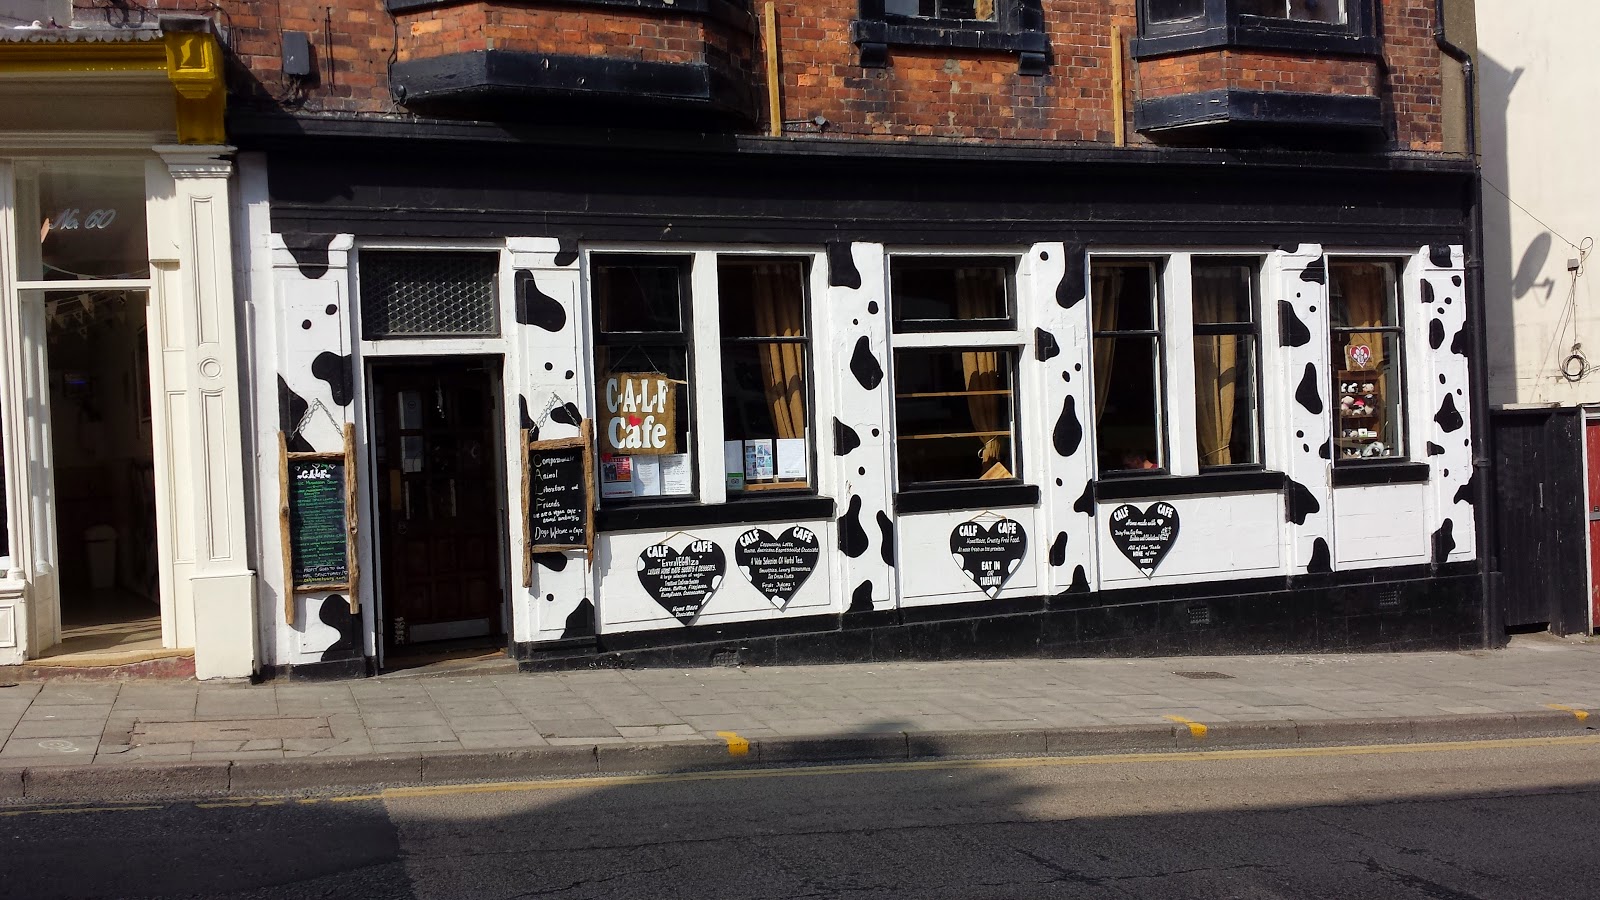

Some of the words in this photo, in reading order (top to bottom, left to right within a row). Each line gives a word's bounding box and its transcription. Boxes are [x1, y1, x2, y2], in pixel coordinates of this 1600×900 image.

[85, 209, 116, 229] 60
[608, 415, 667, 449] Cafe
[1113, 506, 1129, 521] CALF
[1157, 504, 1174, 518] CAFE
[740, 529, 760, 547] CALF
[792, 527, 814, 544] CAFE
[959, 525, 978, 537] CALF
[997, 522, 1017, 534] CAFE
[647, 545, 669, 558] CALF
[691, 540, 713, 553] CAFE
[981, 561, 992, 571] EAT
[993, 560, 1001, 570] IN
[980, 575, 1002, 586] TAKEAWAY
